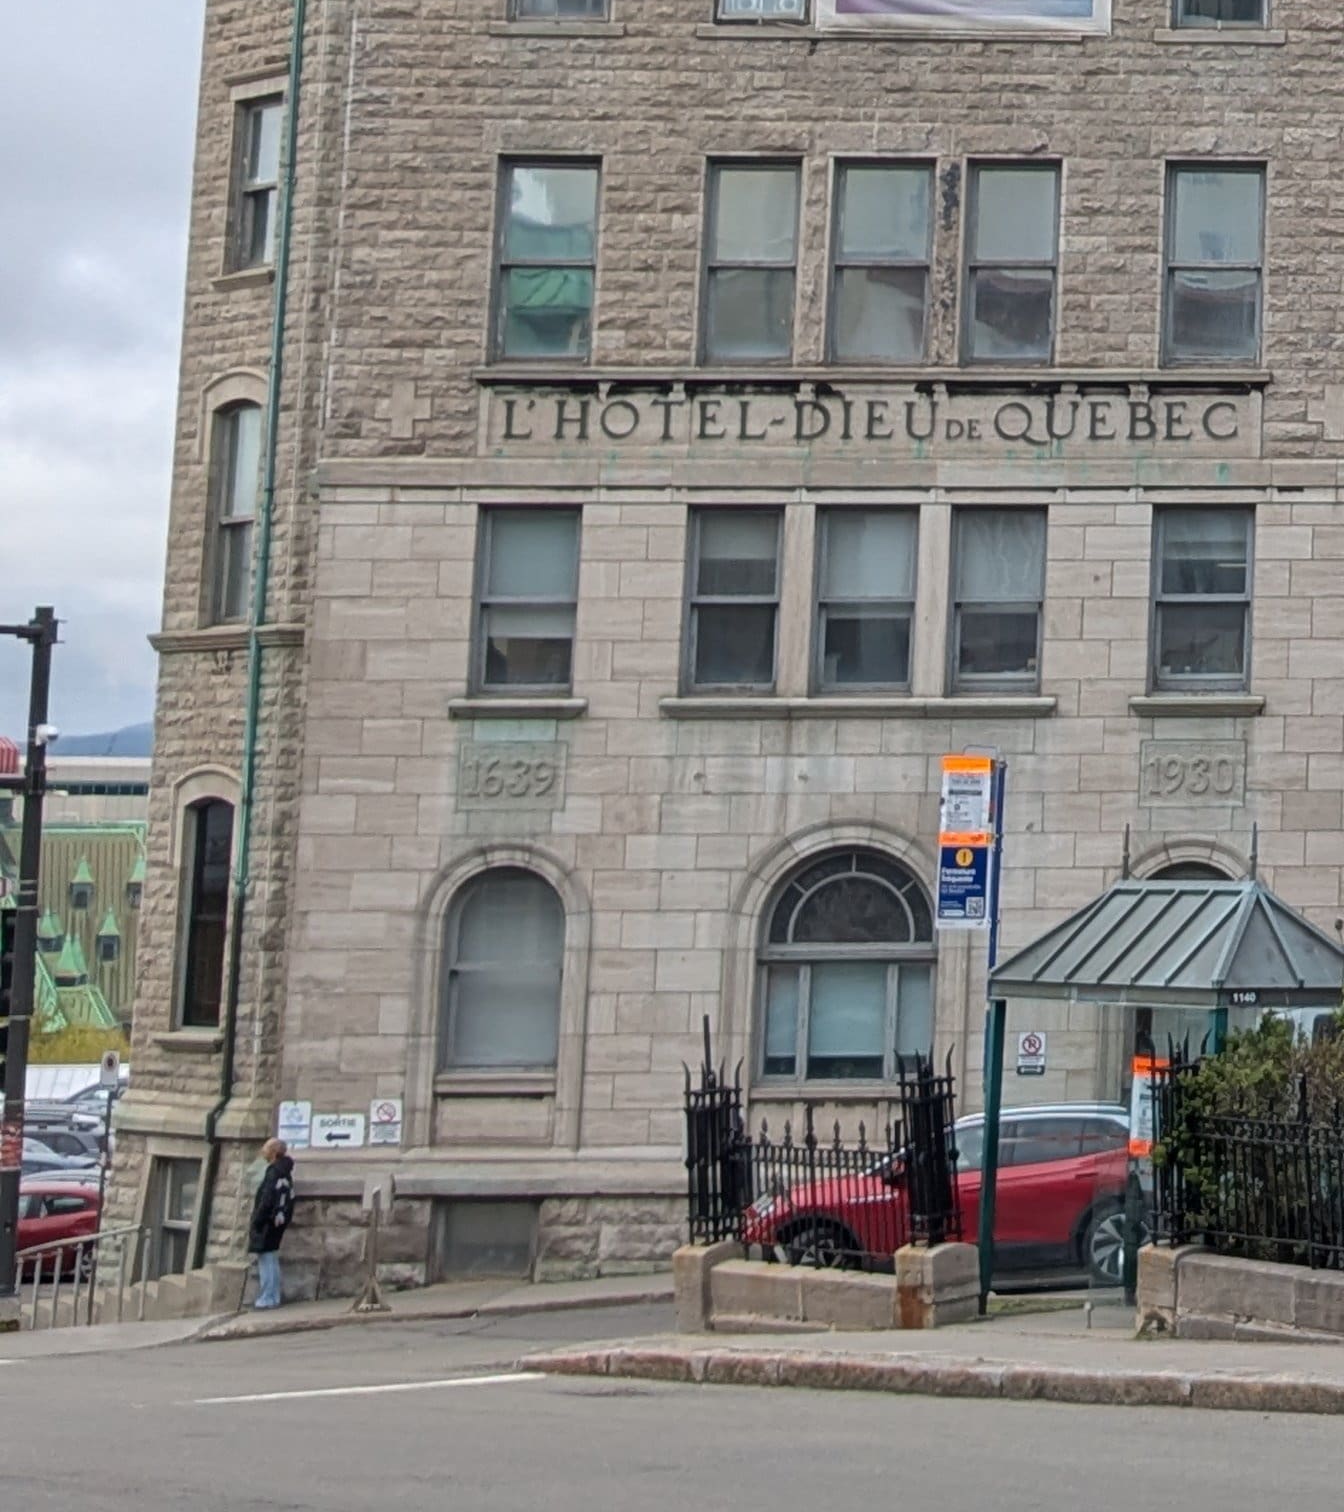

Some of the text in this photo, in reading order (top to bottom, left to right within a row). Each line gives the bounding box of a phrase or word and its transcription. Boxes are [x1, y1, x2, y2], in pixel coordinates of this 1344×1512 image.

[944, 418, 982, 441] DE
[993, 400, 1240, 446] QUEBEC
[463, 756, 556, 798] 1639
[1146, 754, 1236, 795] 1930
